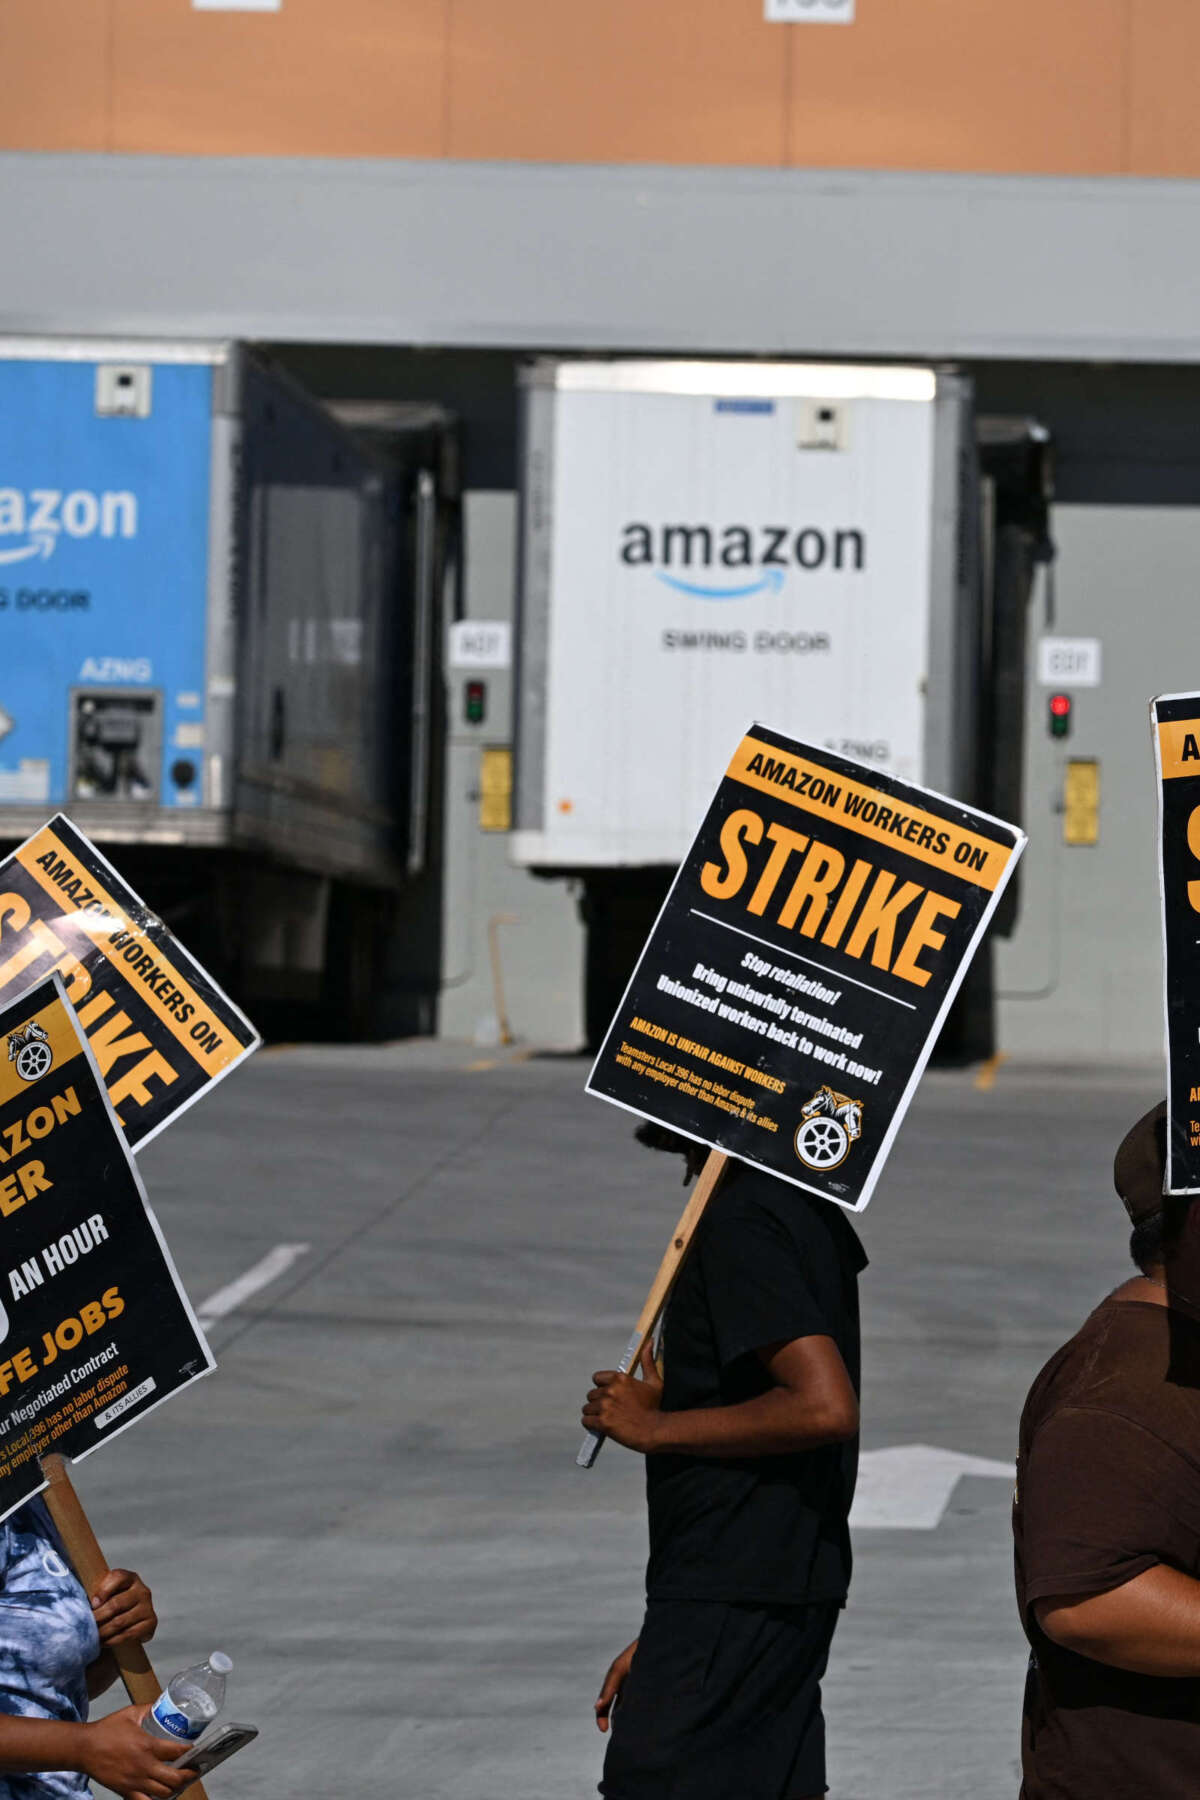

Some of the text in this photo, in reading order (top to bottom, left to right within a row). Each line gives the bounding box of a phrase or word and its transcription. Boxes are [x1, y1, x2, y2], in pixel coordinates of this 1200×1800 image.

[619, 521, 866, 571] amazon
[15, 588, 91, 612] DOOR
[662, 629, 831, 655] SWING DOOR
[746, 753, 989, 871] AMAZON WORKERS ON
[700, 809, 962, 987] STRIKE
[108, 930, 195, 1023] WORKERS
[189, 1021, 224, 1055] ON
[692, 963, 863, 1049] Bring unlawfully terminated
[741, 952, 842, 1006] Stop retaliation!
[630, 1016, 786, 1094] AMAZON IS UNFAIR AGAINST WORKERS
[656, 974, 883, 1085] Unionized workers back to work now!
[8, 1213, 109, 1301] AN HOUR
[42, 1286, 125, 1366] JOBS
[11, 1342, 119, 1426] Negotiated Contract
[50, 1380, 128, 1441] other than Amazon
